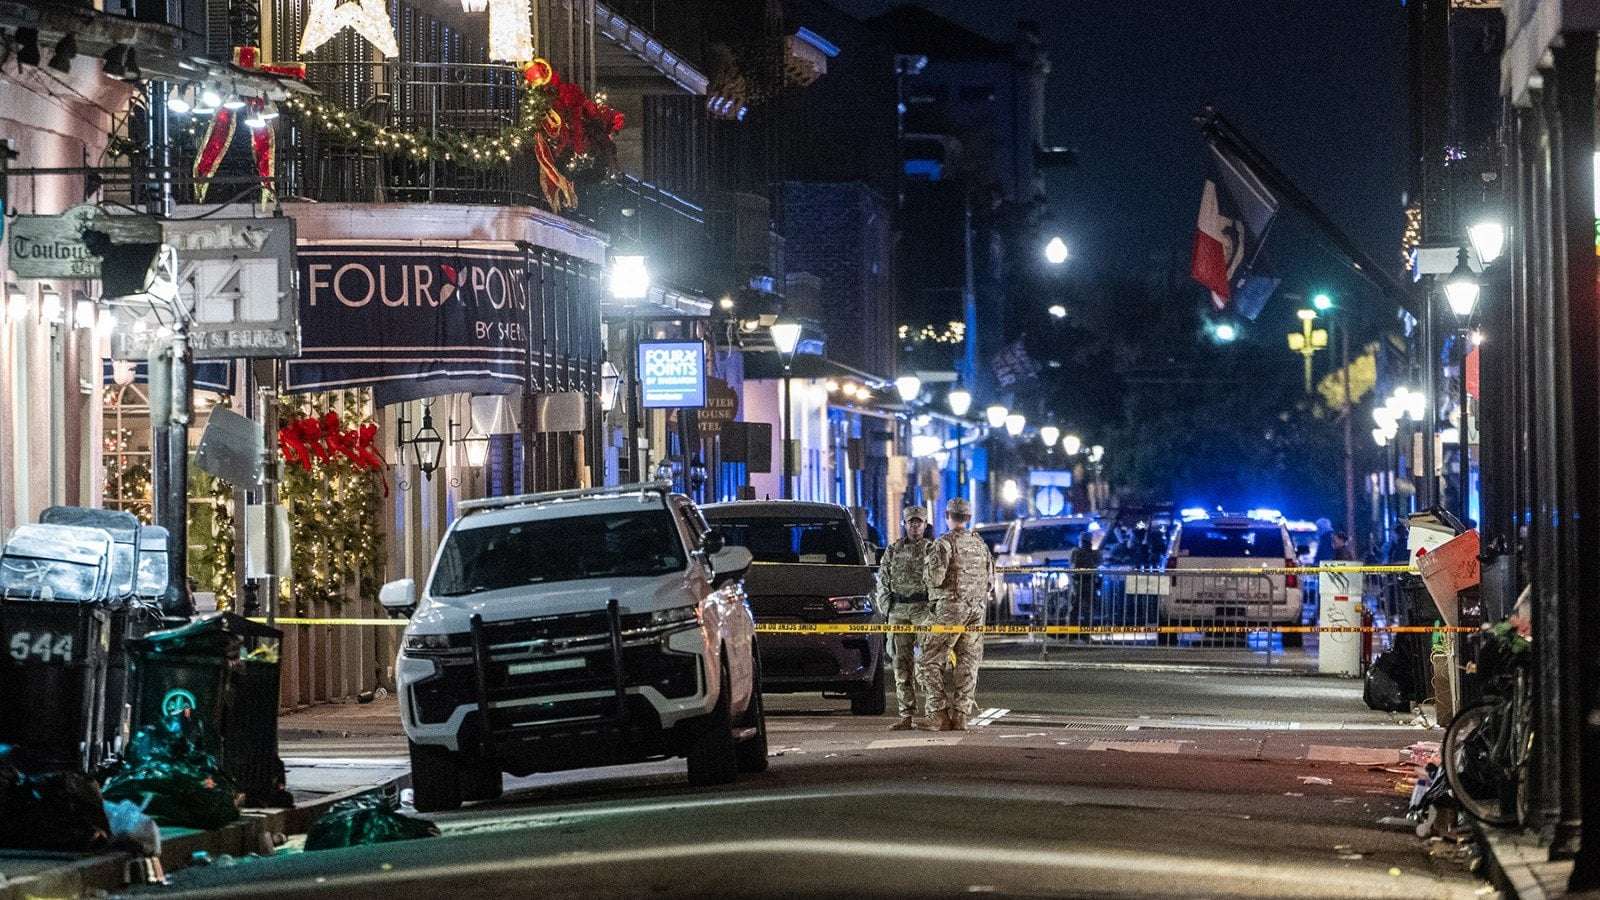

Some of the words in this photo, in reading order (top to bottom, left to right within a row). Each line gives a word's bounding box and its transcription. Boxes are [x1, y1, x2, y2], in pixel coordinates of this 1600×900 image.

[309, 263, 439, 308] FOUR
[475, 321, 494, 340] BY
[645, 349, 683, 361] FOUR
[645, 361, 698, 376] POINTS
[10, 632, 73, 662] 544
